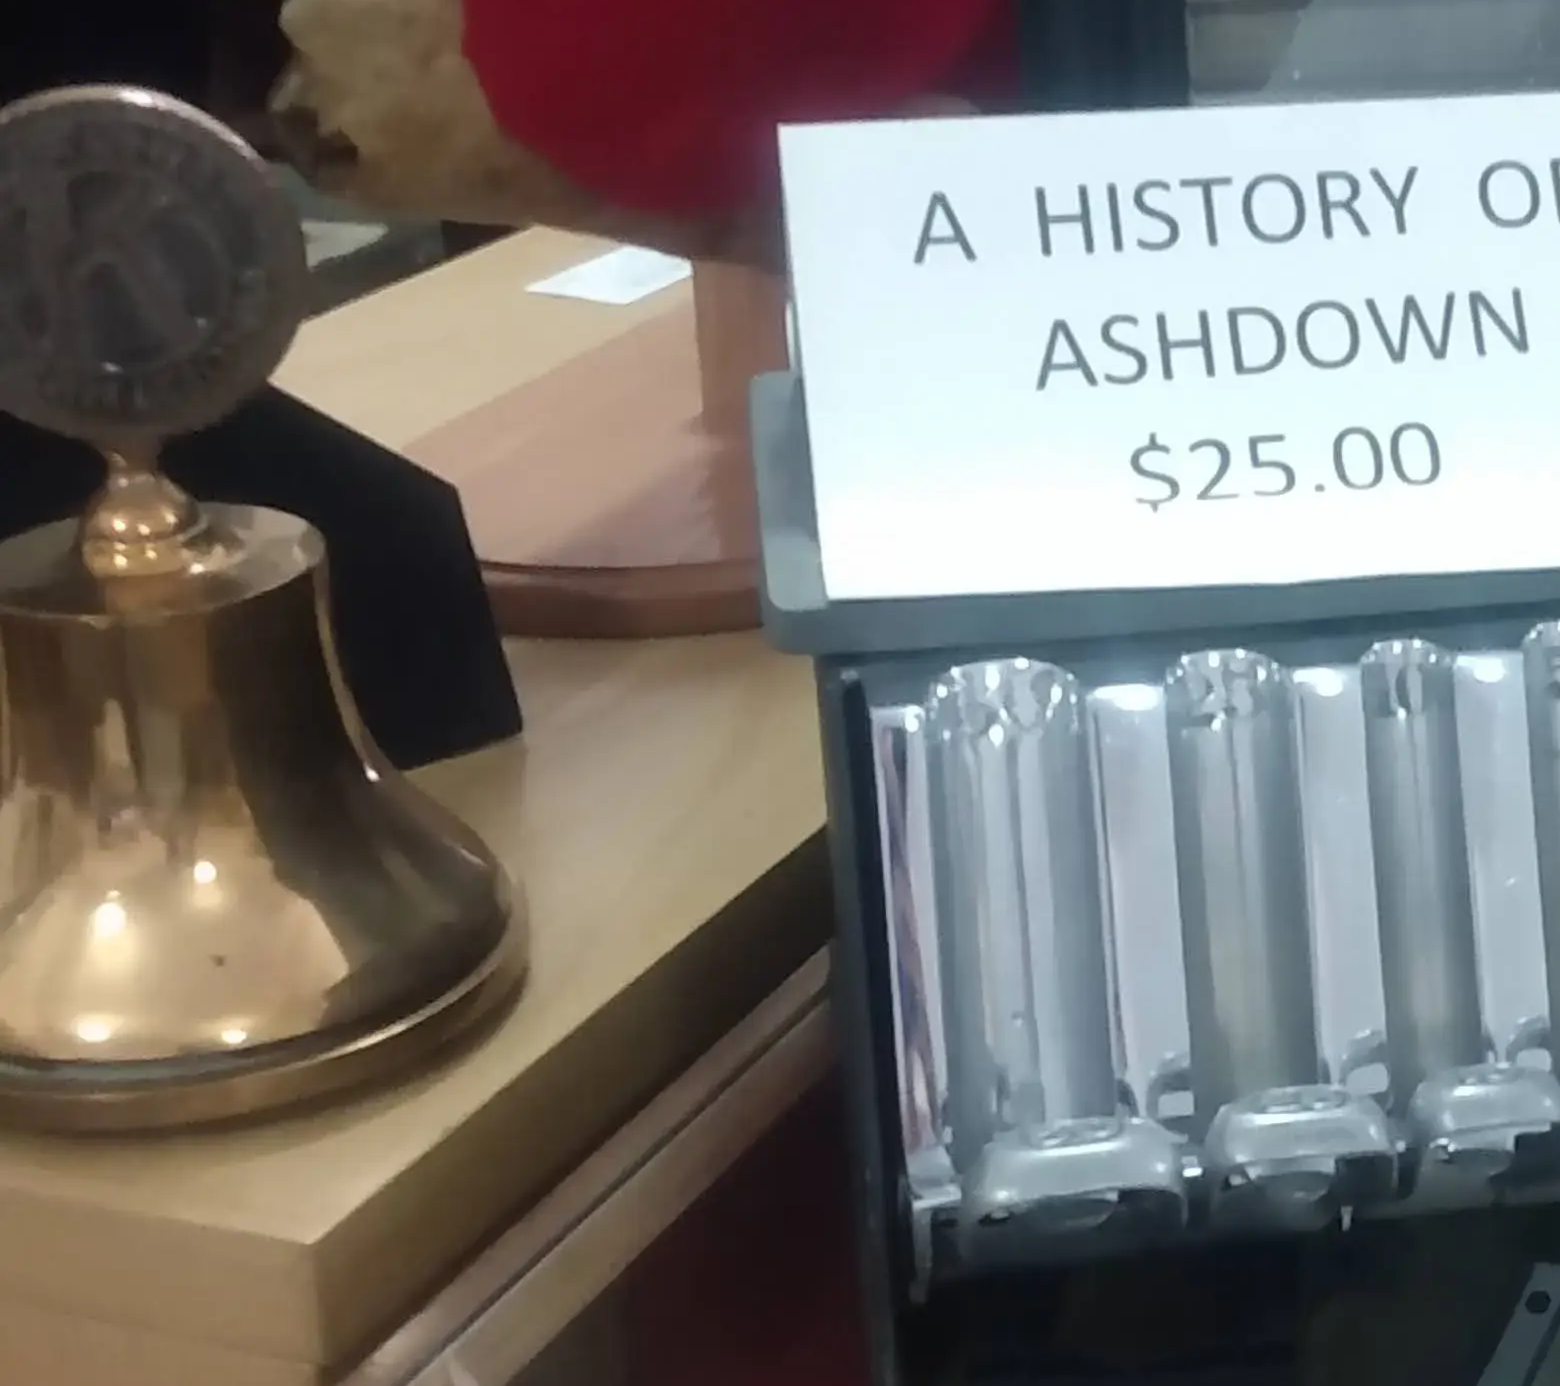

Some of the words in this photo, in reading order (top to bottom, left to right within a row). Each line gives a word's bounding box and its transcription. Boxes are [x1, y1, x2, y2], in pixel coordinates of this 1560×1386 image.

[913, 191, 978, 265] A
[1034, 165, 1420, 258] HISTORY
[1036, 287, 1531, 391] ASHDOWN
[1129, 422, 1442, 510] $25.00
